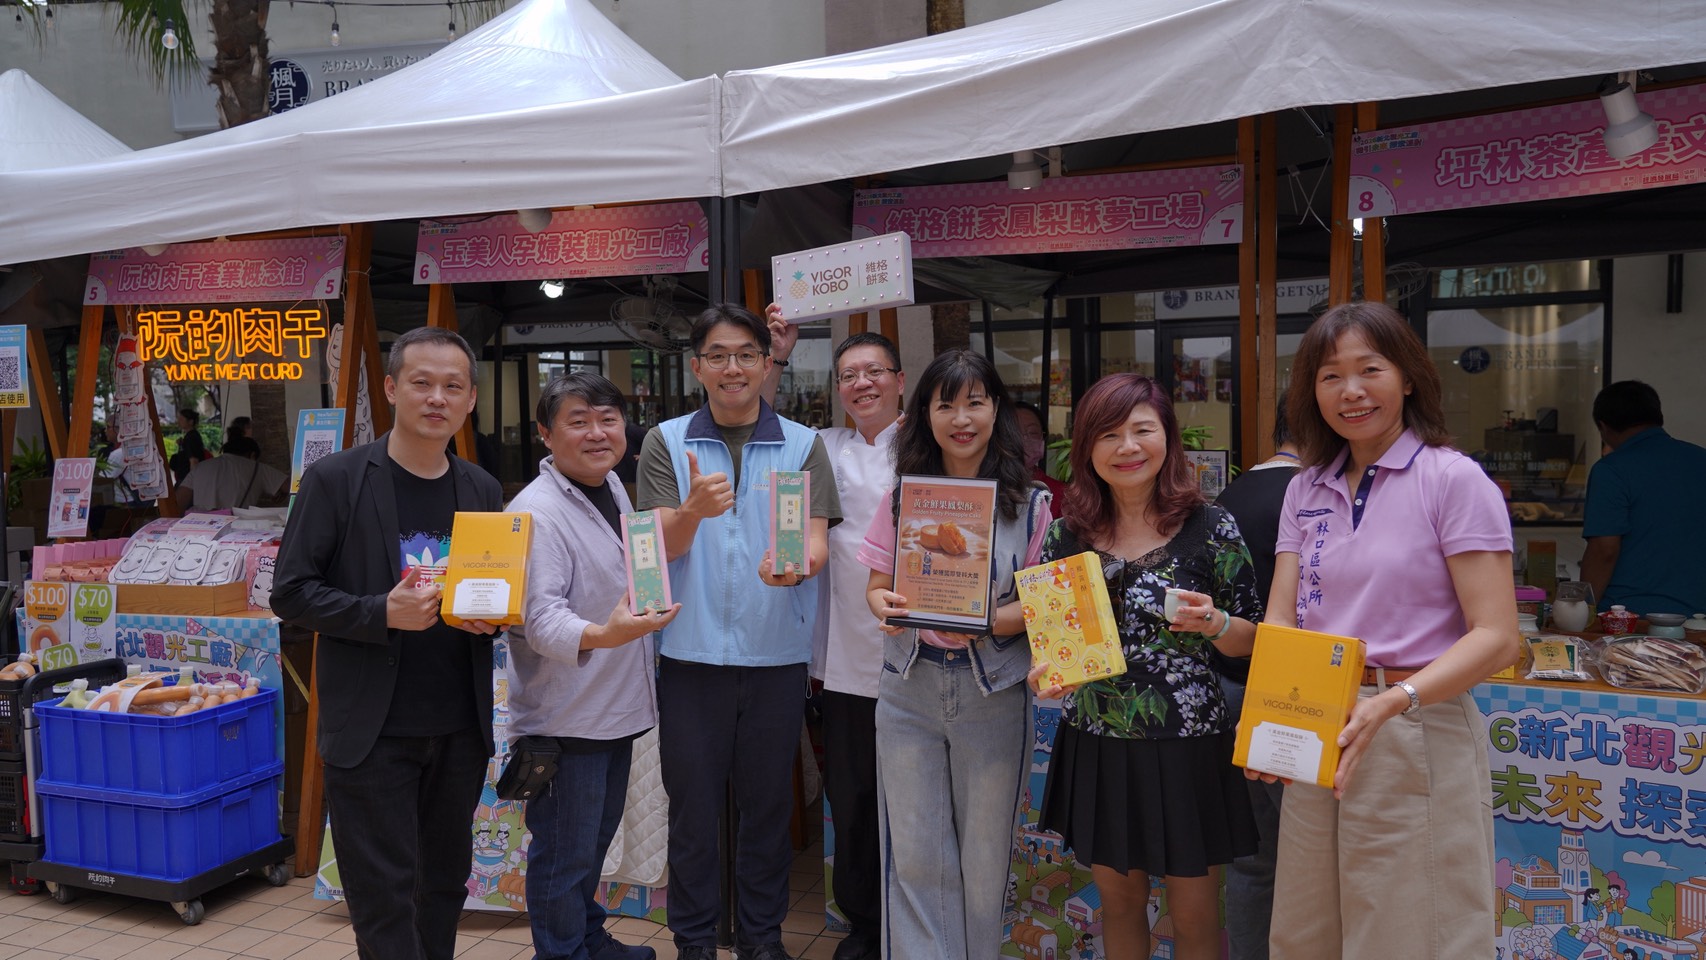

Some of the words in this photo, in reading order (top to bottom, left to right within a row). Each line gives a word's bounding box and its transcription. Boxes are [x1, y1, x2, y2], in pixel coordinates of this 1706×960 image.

[321, 53, 432, 73] 売りたい人、買いたい
[271, 67, 296, 108] 楓月
[1358, 190, 1374, 212] 8
[1221, 218, 1235, 238] 7
[441, 224, 691, 269] 玉美人孕婦裝觀光工廠
[118, 256, 308, 292] 阮的肉干產業概念館
[419, 264, 429, 280] 6
[811, 264, 852, 283] VIGOR
[865, 259, 888, 274] 維格
[325, 279, 335, 294] 5
[812, 279, 849, 297] KOBO
[866, 271, 889, 286] 餅家
[89, 286, 98, 301] 5
[1195, 289, 1240, 302] BRAN
[137, 308, 326, 363] 阮的肉干
[164, 363, 213, 381] YUNYE
[215, 364, 258, 381] MEAT
[259, 362, 303, 381] CURD
[56, 462, 92, 481] $100
[1308, 521, 1330, 606] 林口區公所
[27, 585, 66, 606] $100
[79, 587, 108, 608] $70
[45, 647, 73, 671] $70
[1263, 698, 1292, 712] VIGOR
[1294, 705, 1324, 718] KOBO
[1491, 765, 1604, 823] 未來
[88, 872, 116, 885] 阮的肉干
